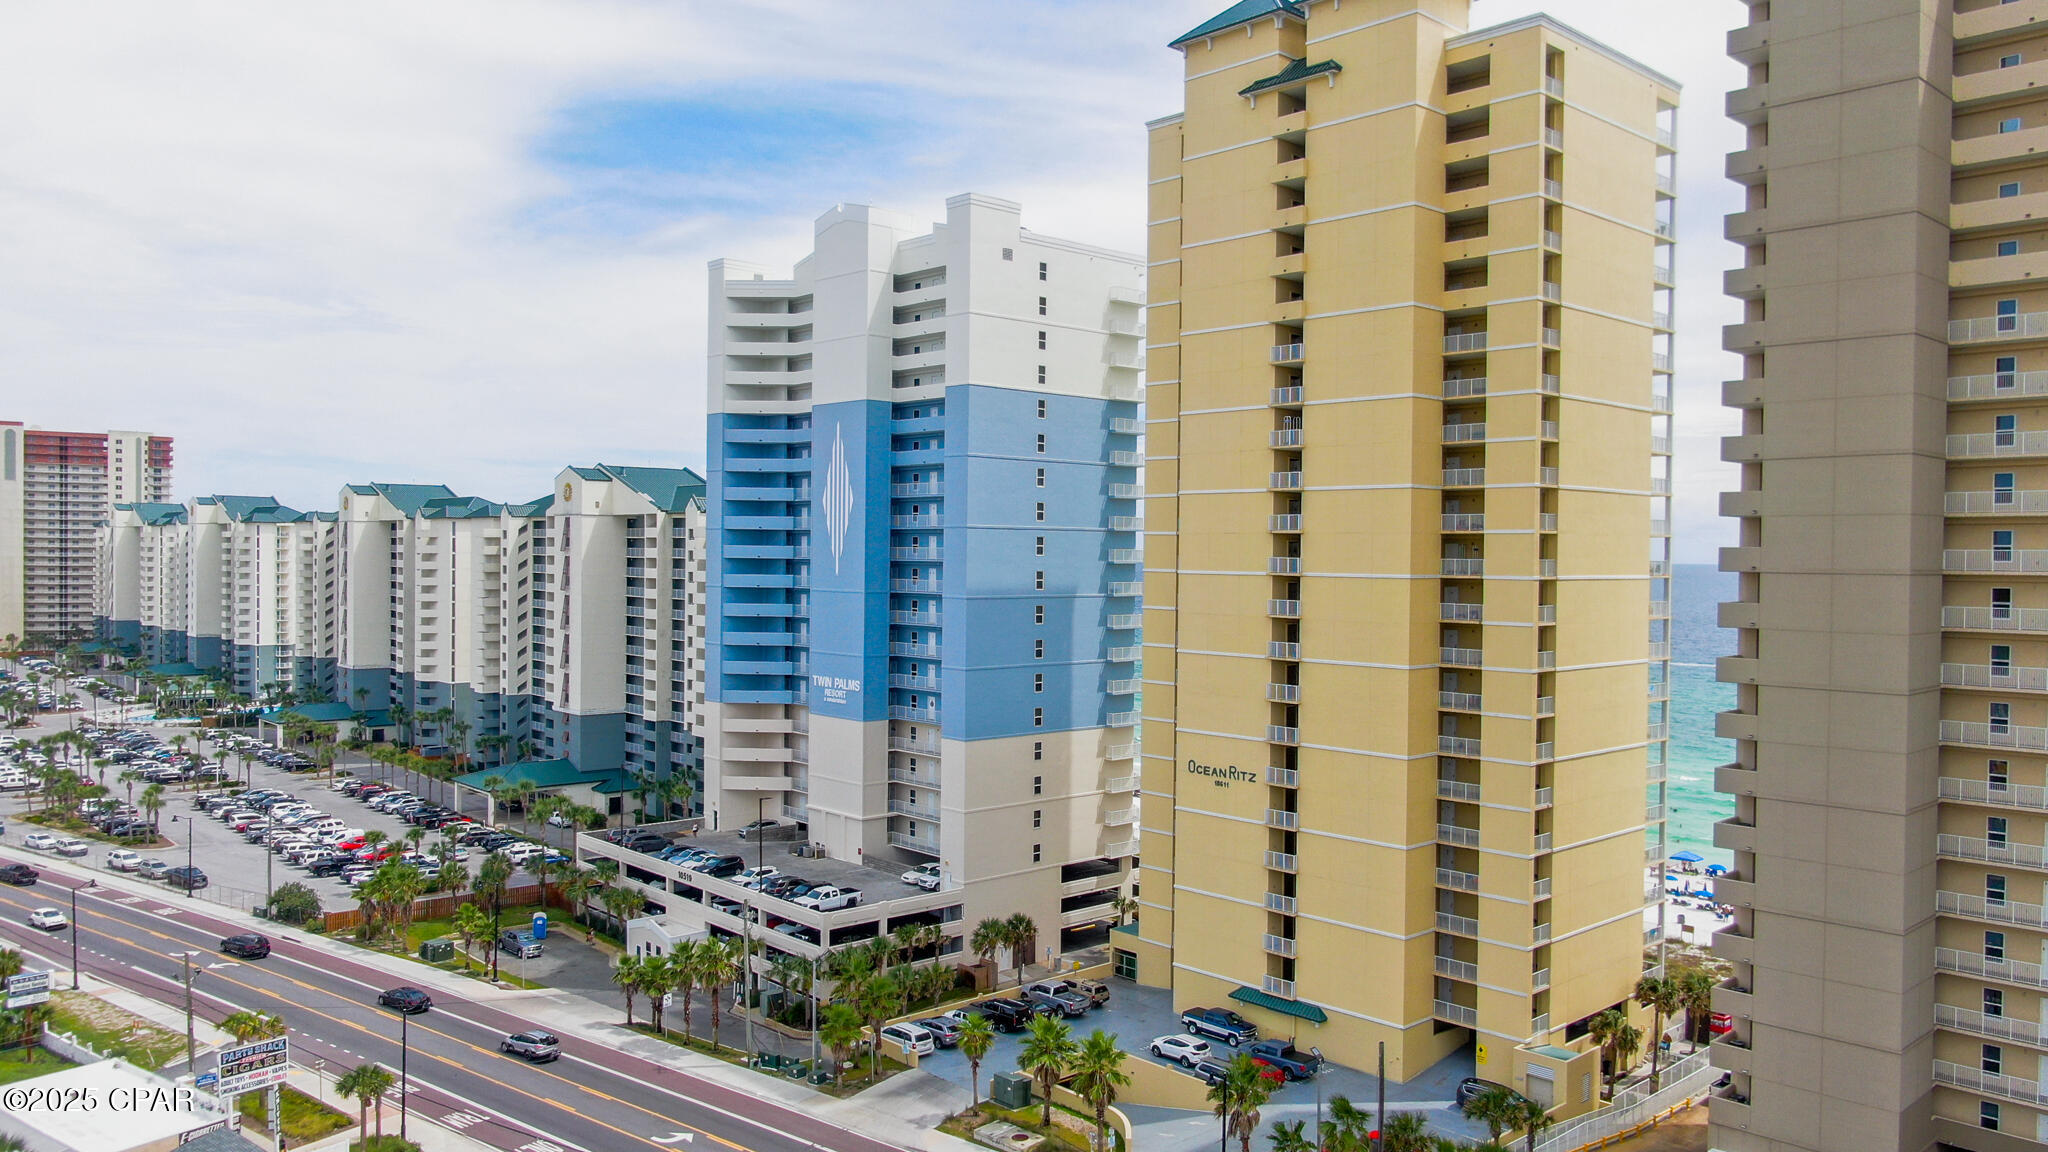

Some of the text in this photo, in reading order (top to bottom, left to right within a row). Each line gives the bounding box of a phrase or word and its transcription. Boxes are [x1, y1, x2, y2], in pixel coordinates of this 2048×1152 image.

[812, 675, 860, 692] TWIN PALMS
[223, 1039, 285, 1064] PARTY SHACK
[222, 1053, 286, 1077] CIGARS
[440, 1109, 491, 1129] TRAM
